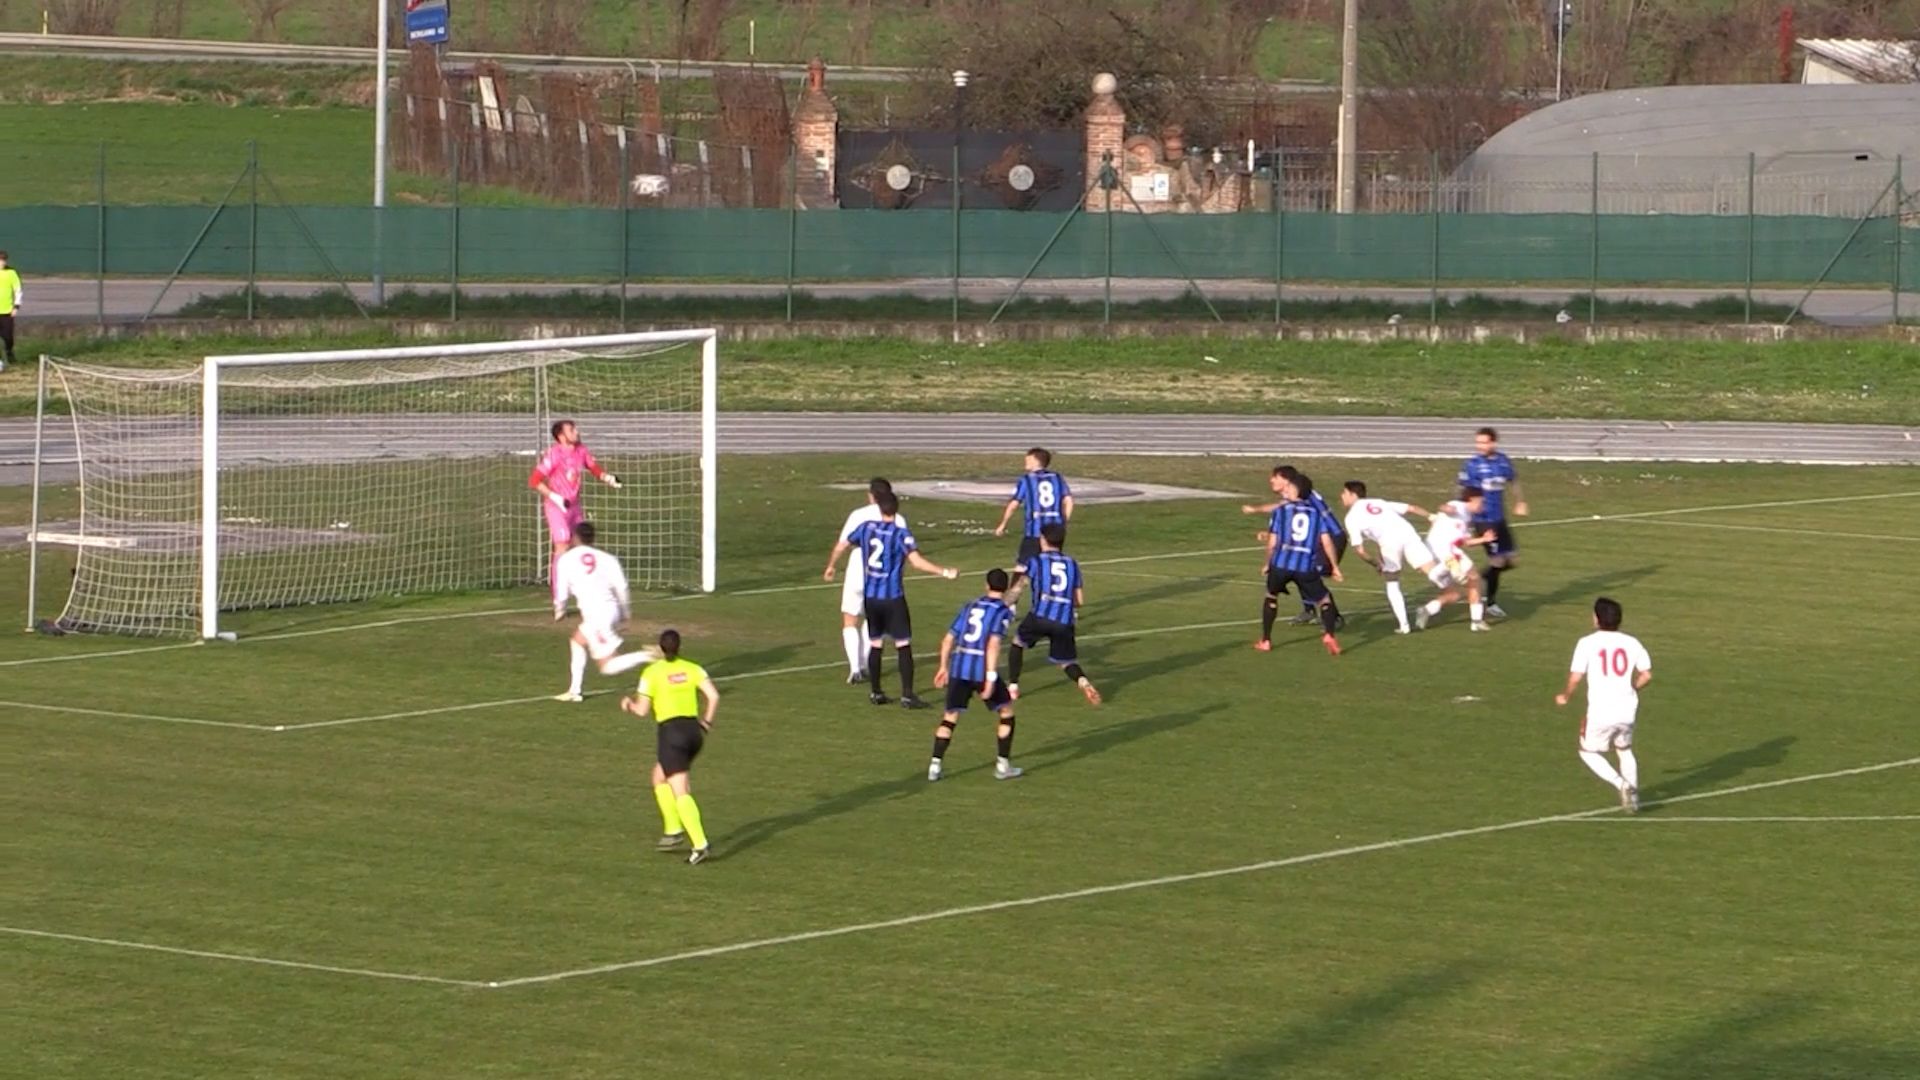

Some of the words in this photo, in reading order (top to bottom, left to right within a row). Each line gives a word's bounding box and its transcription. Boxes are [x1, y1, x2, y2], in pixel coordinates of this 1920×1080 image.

[1038, 481, 1054, 507] 8
[1366, 503, 1383, 515] 6
[1291, 513, 1310, 542] 9
[580, 552, 597, 575] 9
[868, 537, 884, 568] 2
[1050, 562, 1067, 592] 5
[964, 608, 984, 643] 3
[1598, 647, 1629, 678] 10
